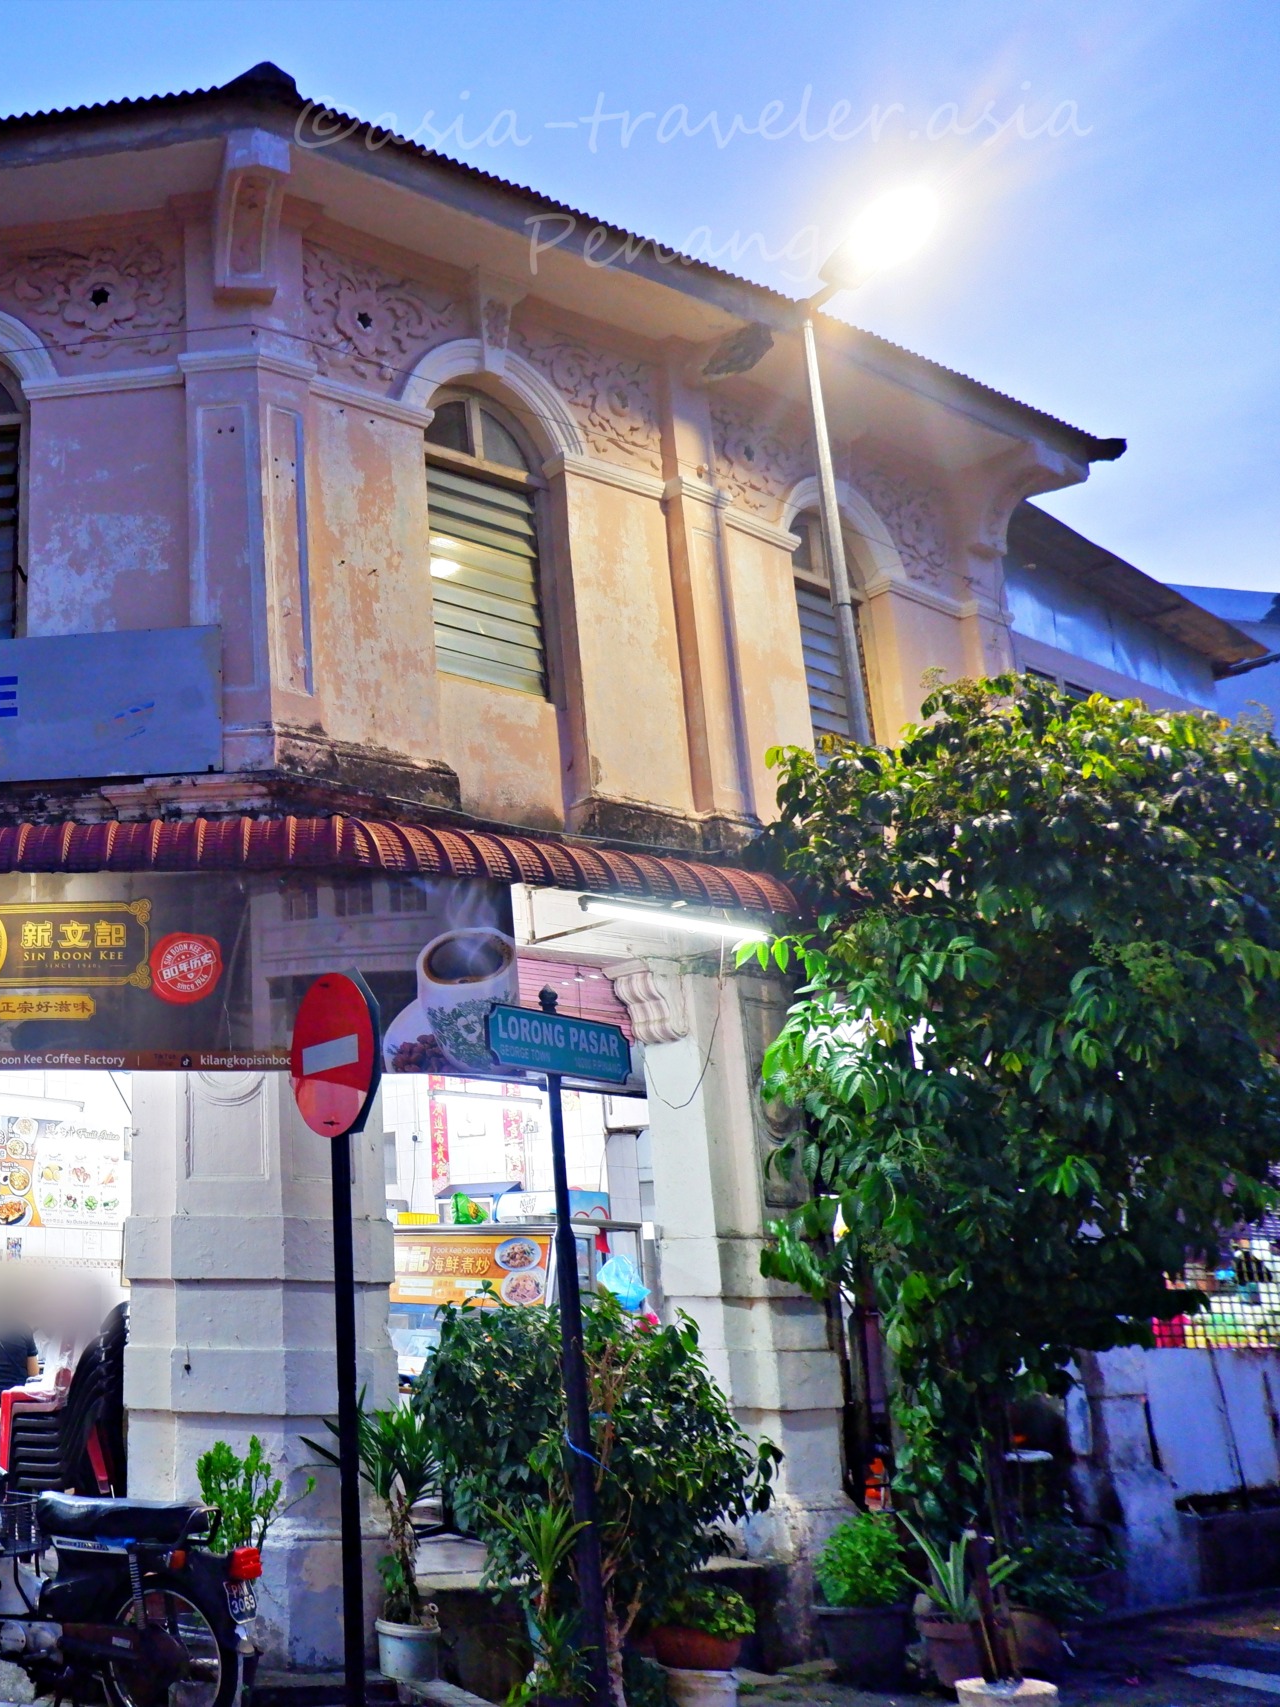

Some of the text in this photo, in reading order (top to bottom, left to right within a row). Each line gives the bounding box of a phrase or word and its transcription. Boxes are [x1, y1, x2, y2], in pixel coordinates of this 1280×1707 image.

[23, 951, 124, 962] SIN BOON KEE
[163, 943, 202, 966] SIN BOON KEE
[162, 952, 213, 980] 80年历史
[176, 982, 195, 990] since
[0, 1000, 92, 1015] 正宗好滋味
[497, 1013, 621, 1058] LORONG PASAR
[23, 1054, 43, 1064] Kee
[45, 1054, 81, 1064] Coffee
[84, 1054, 125, 1067] Factory
[499, 1044, 552, 1064] GEORGE TOWN
[76, 1128, 120, 1141] Fruit Juice
[463, 1246, 492, 1255] Seafood
[76, 1541, 109, 1551] HONDA
[231, 1594, 256, 1614] 3069
